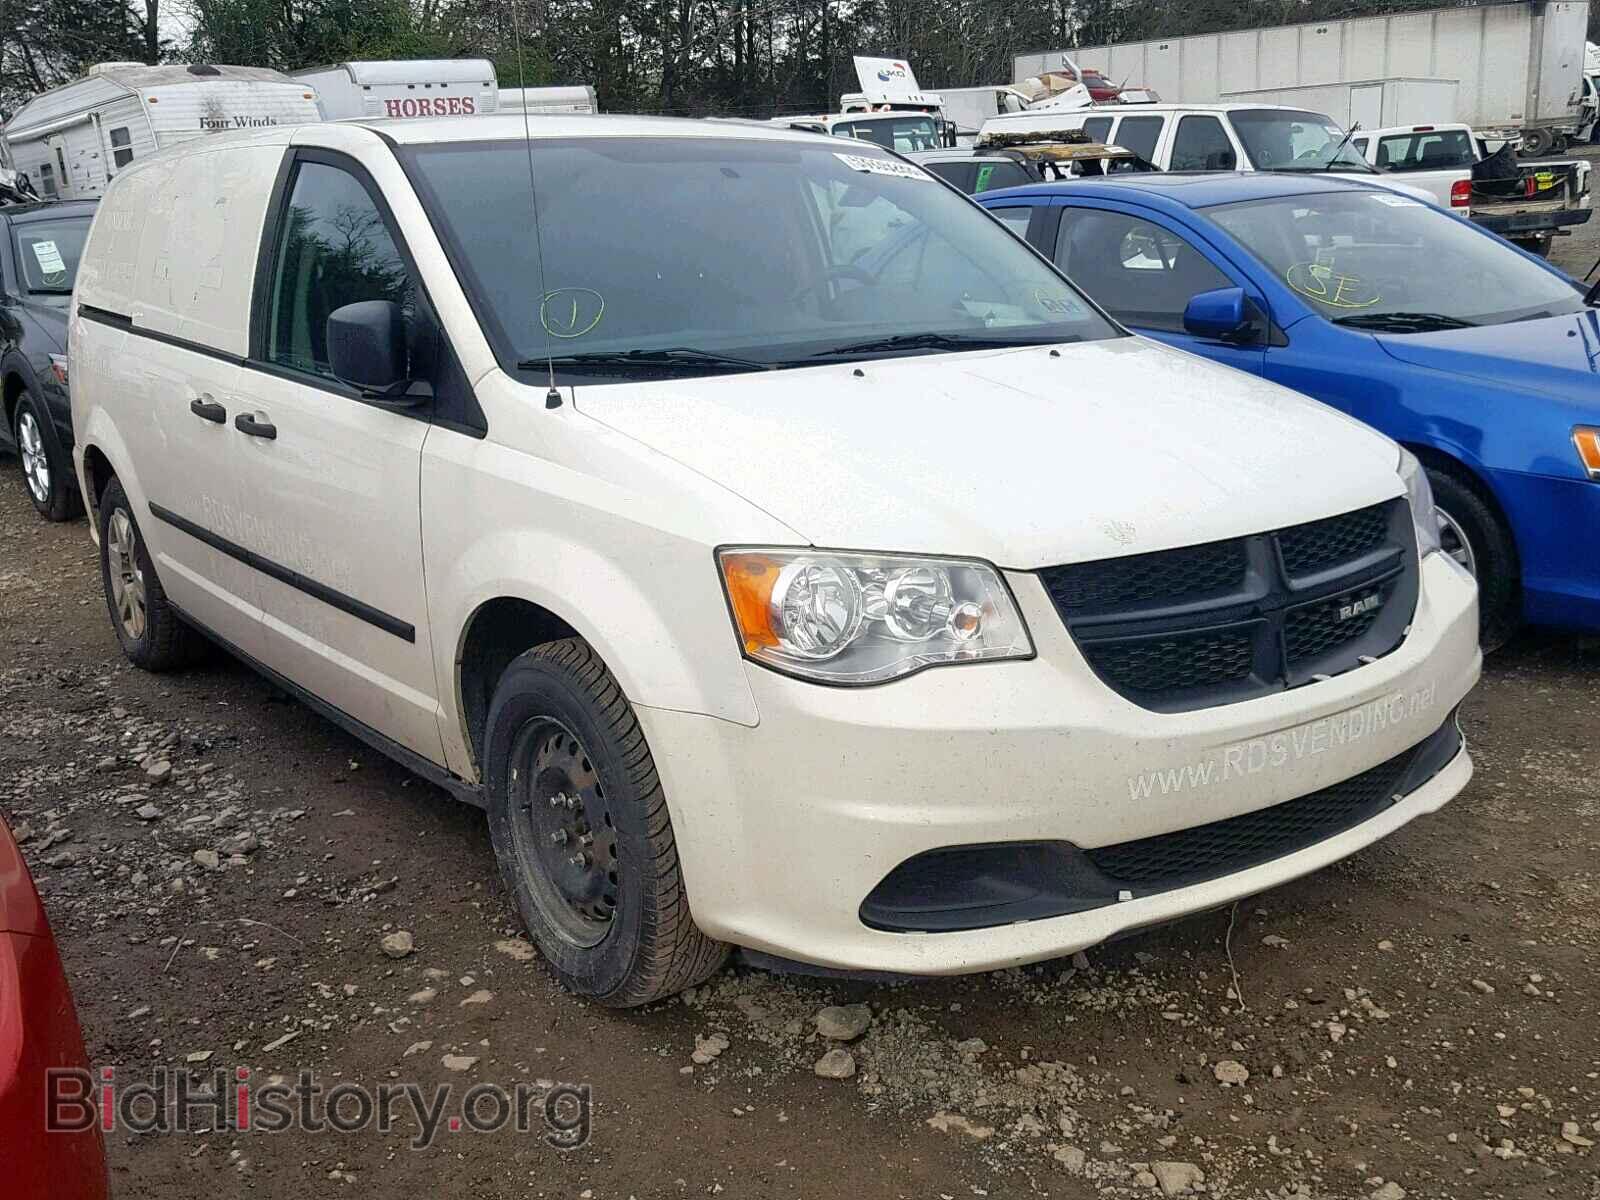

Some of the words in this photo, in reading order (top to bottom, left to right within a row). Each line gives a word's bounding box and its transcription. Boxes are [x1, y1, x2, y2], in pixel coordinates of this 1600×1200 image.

[384, 97, 476, 118] HORSES
[199, 116, 231, 129] Four
[233, 115, 277, 128] Winds
[1339, 594, 1378, 620] RAM
